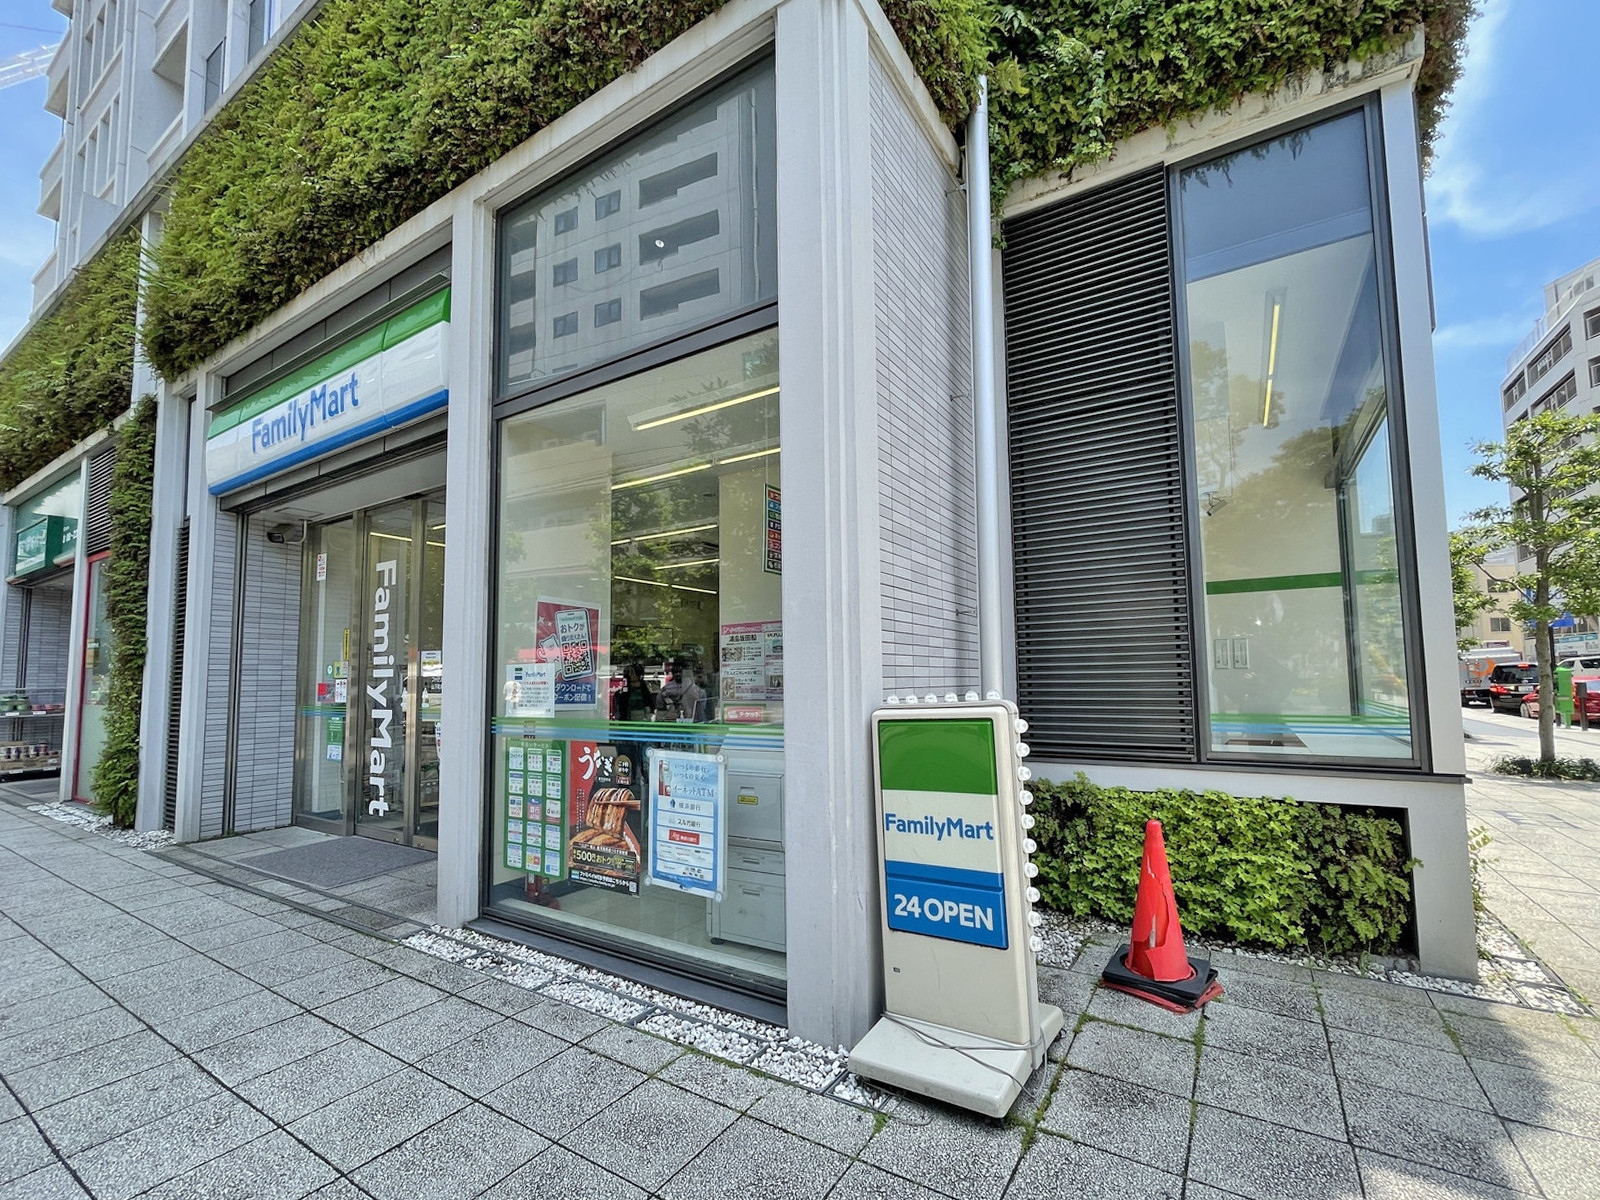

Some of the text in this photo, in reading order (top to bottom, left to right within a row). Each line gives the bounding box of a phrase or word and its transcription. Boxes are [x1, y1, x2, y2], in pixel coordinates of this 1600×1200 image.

[251, 372, 361, 454] FamilyMart
[560, 622, 585, 634] おトクが
[368, 560, 396, 817] FamilyMart
[578, 746, 614, 780] うなぎ
[884, 813, 994, 841] FamilyMart
